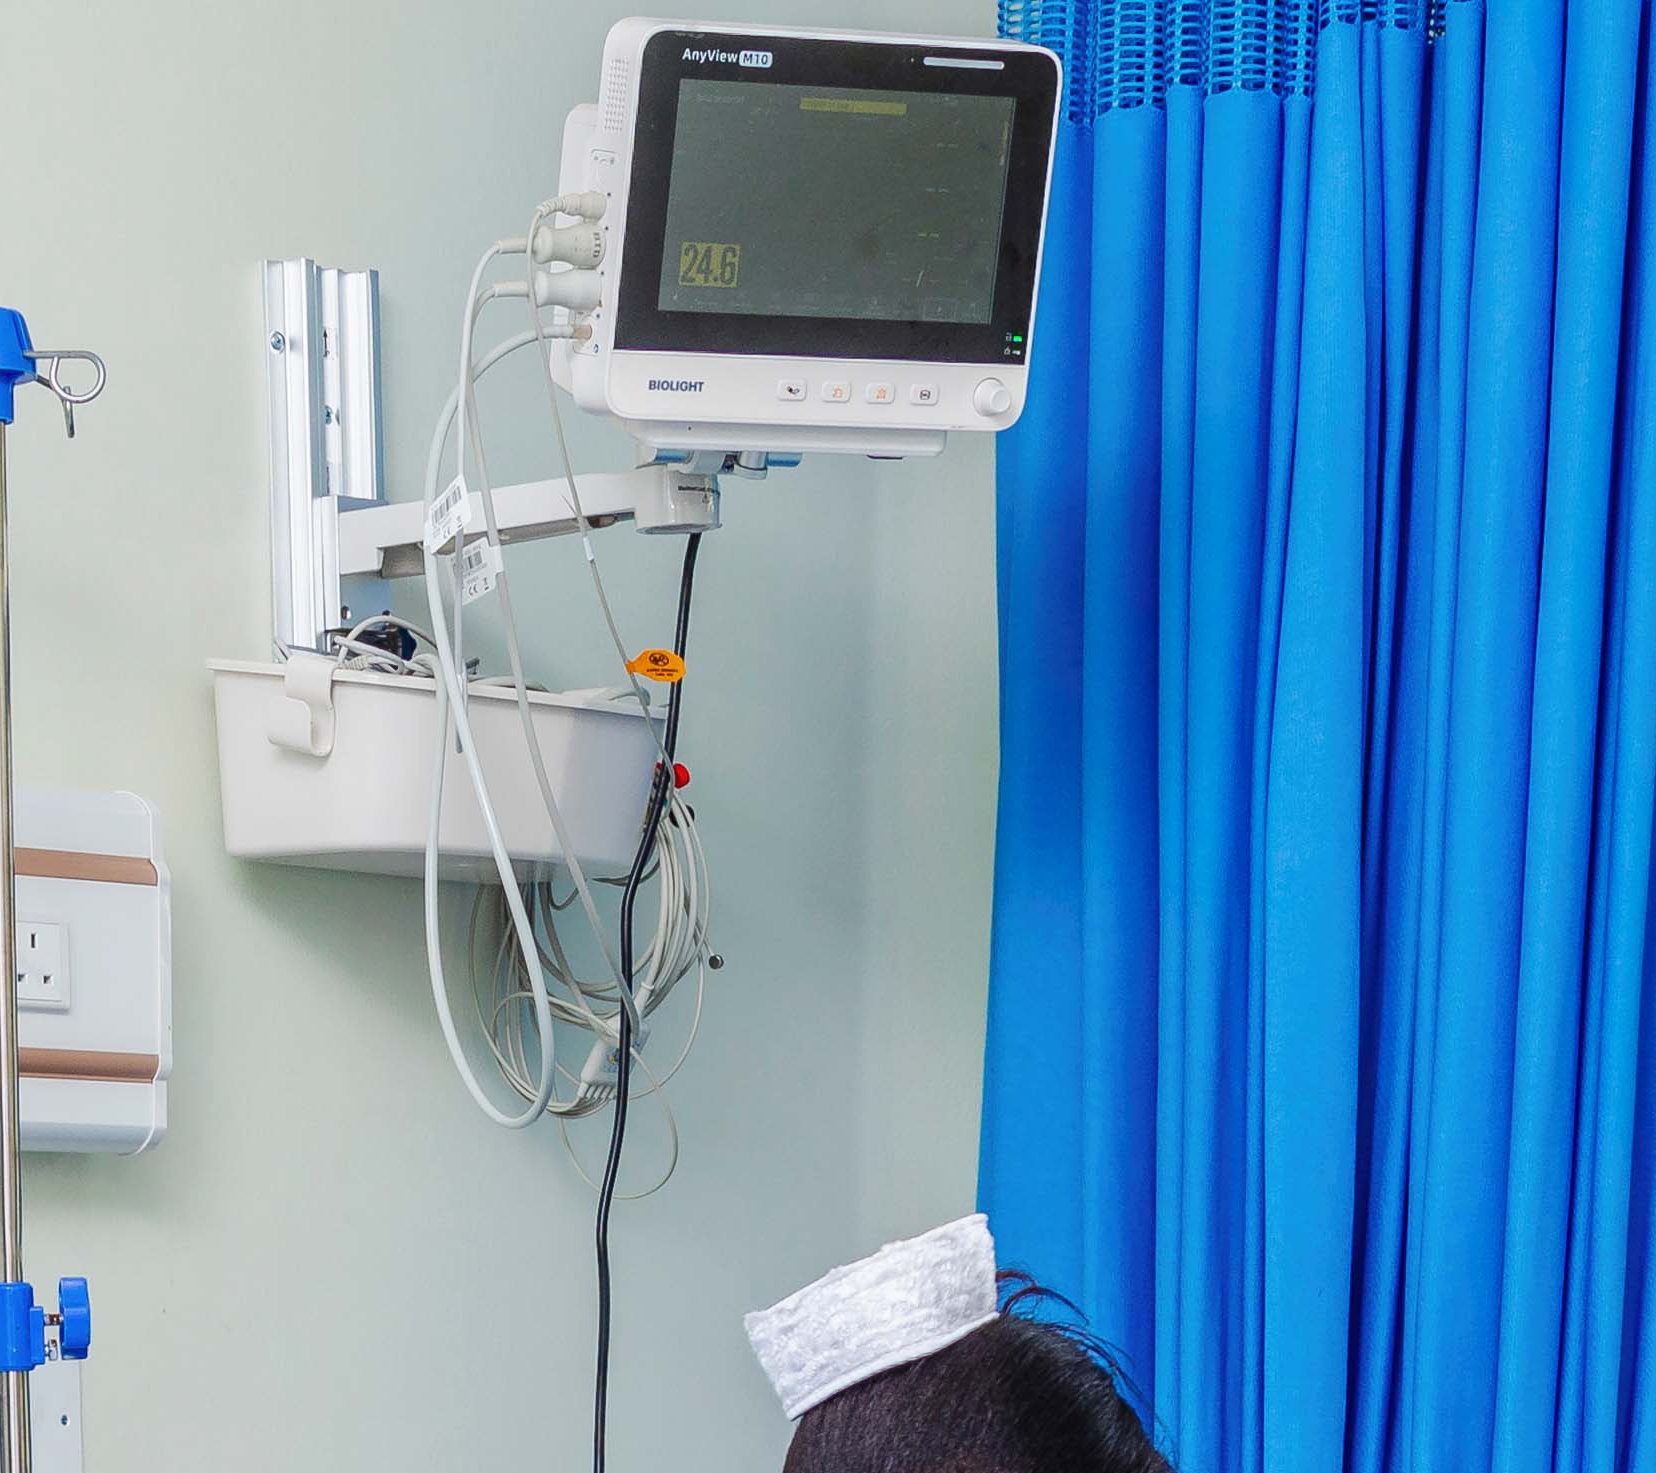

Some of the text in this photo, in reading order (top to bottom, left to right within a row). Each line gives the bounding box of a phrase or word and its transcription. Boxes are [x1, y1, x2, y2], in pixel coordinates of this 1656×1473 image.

[682, 47, 770, 66] AnyView M10
[680, 243, 739, 286] 24.6
[648, 379, 705, 393] BIOLIGHT
